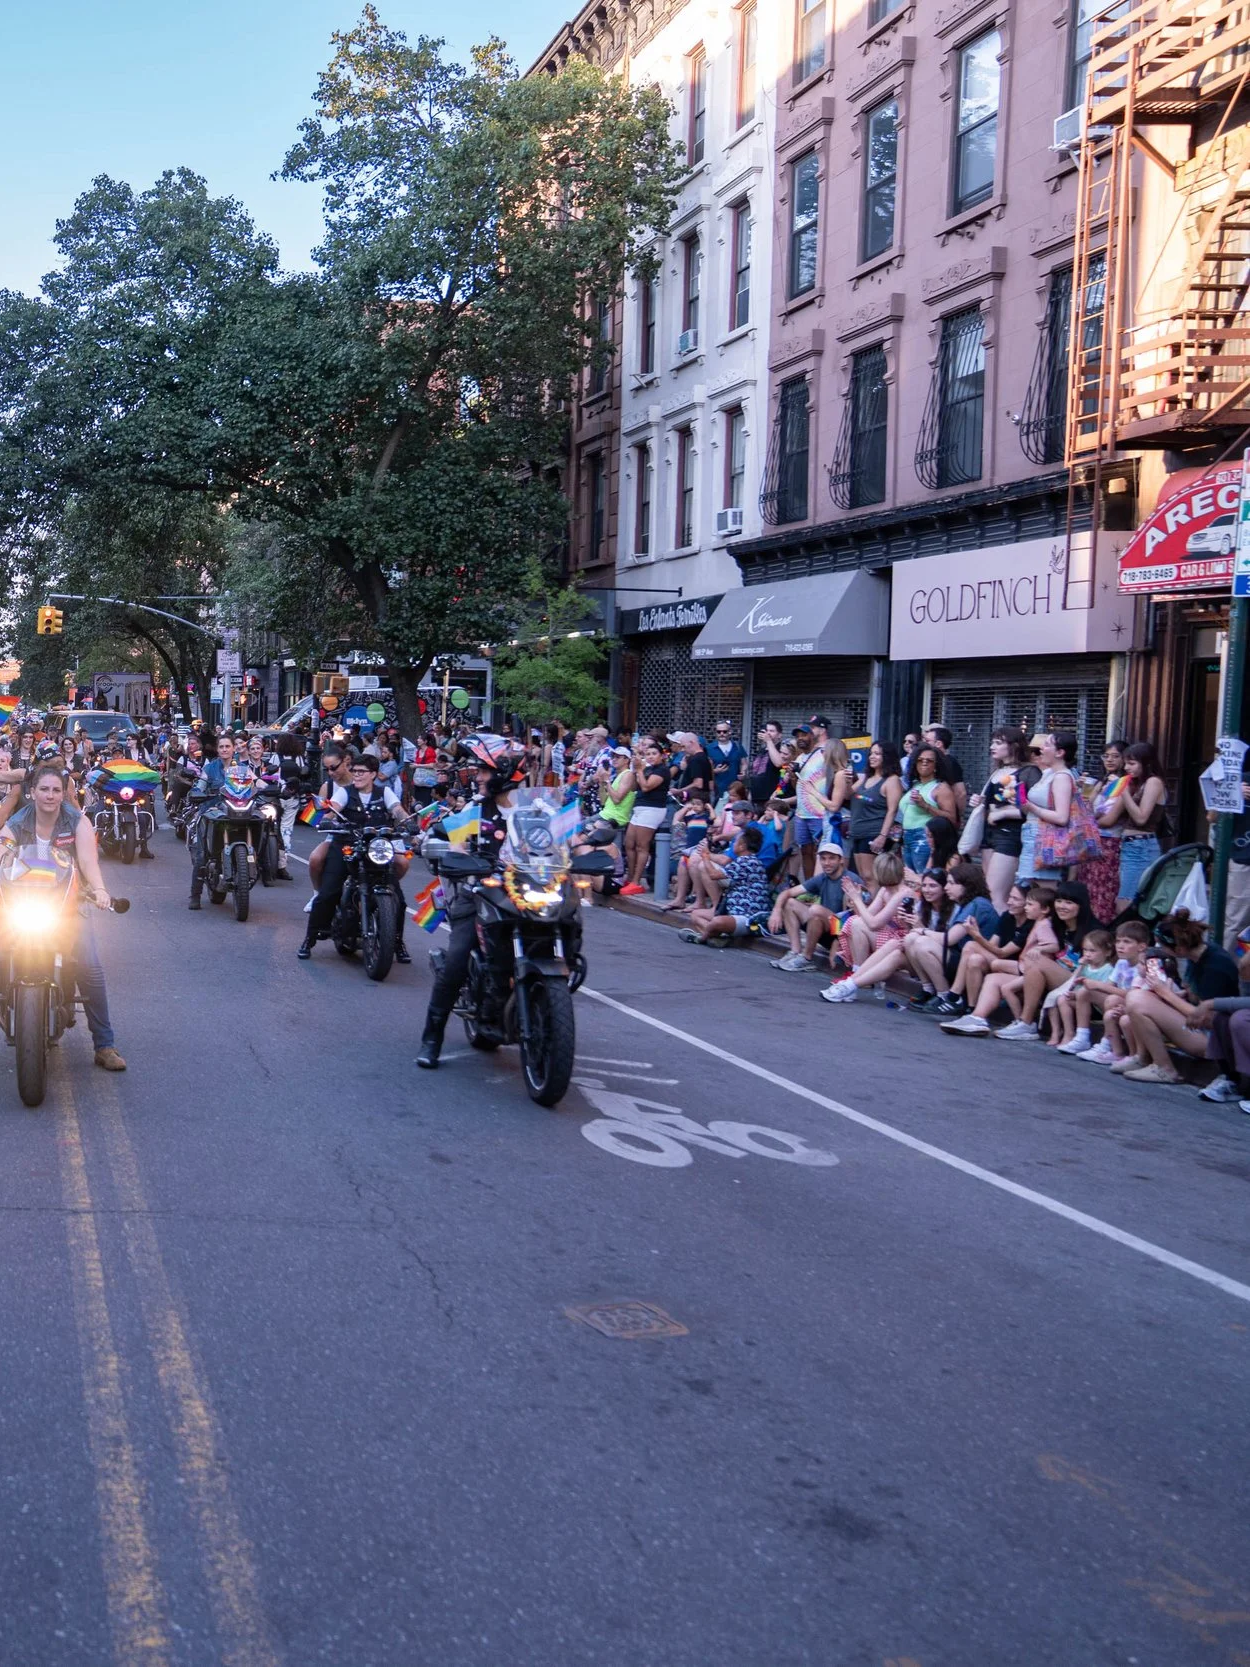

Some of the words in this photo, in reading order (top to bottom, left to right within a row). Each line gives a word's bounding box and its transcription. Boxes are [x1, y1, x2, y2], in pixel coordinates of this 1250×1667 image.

[1180, 566, 1198, 578] CAR
[910, 574, 1051, 624] GOLDFINCH
[650, 606, 676, 631] Enfants
